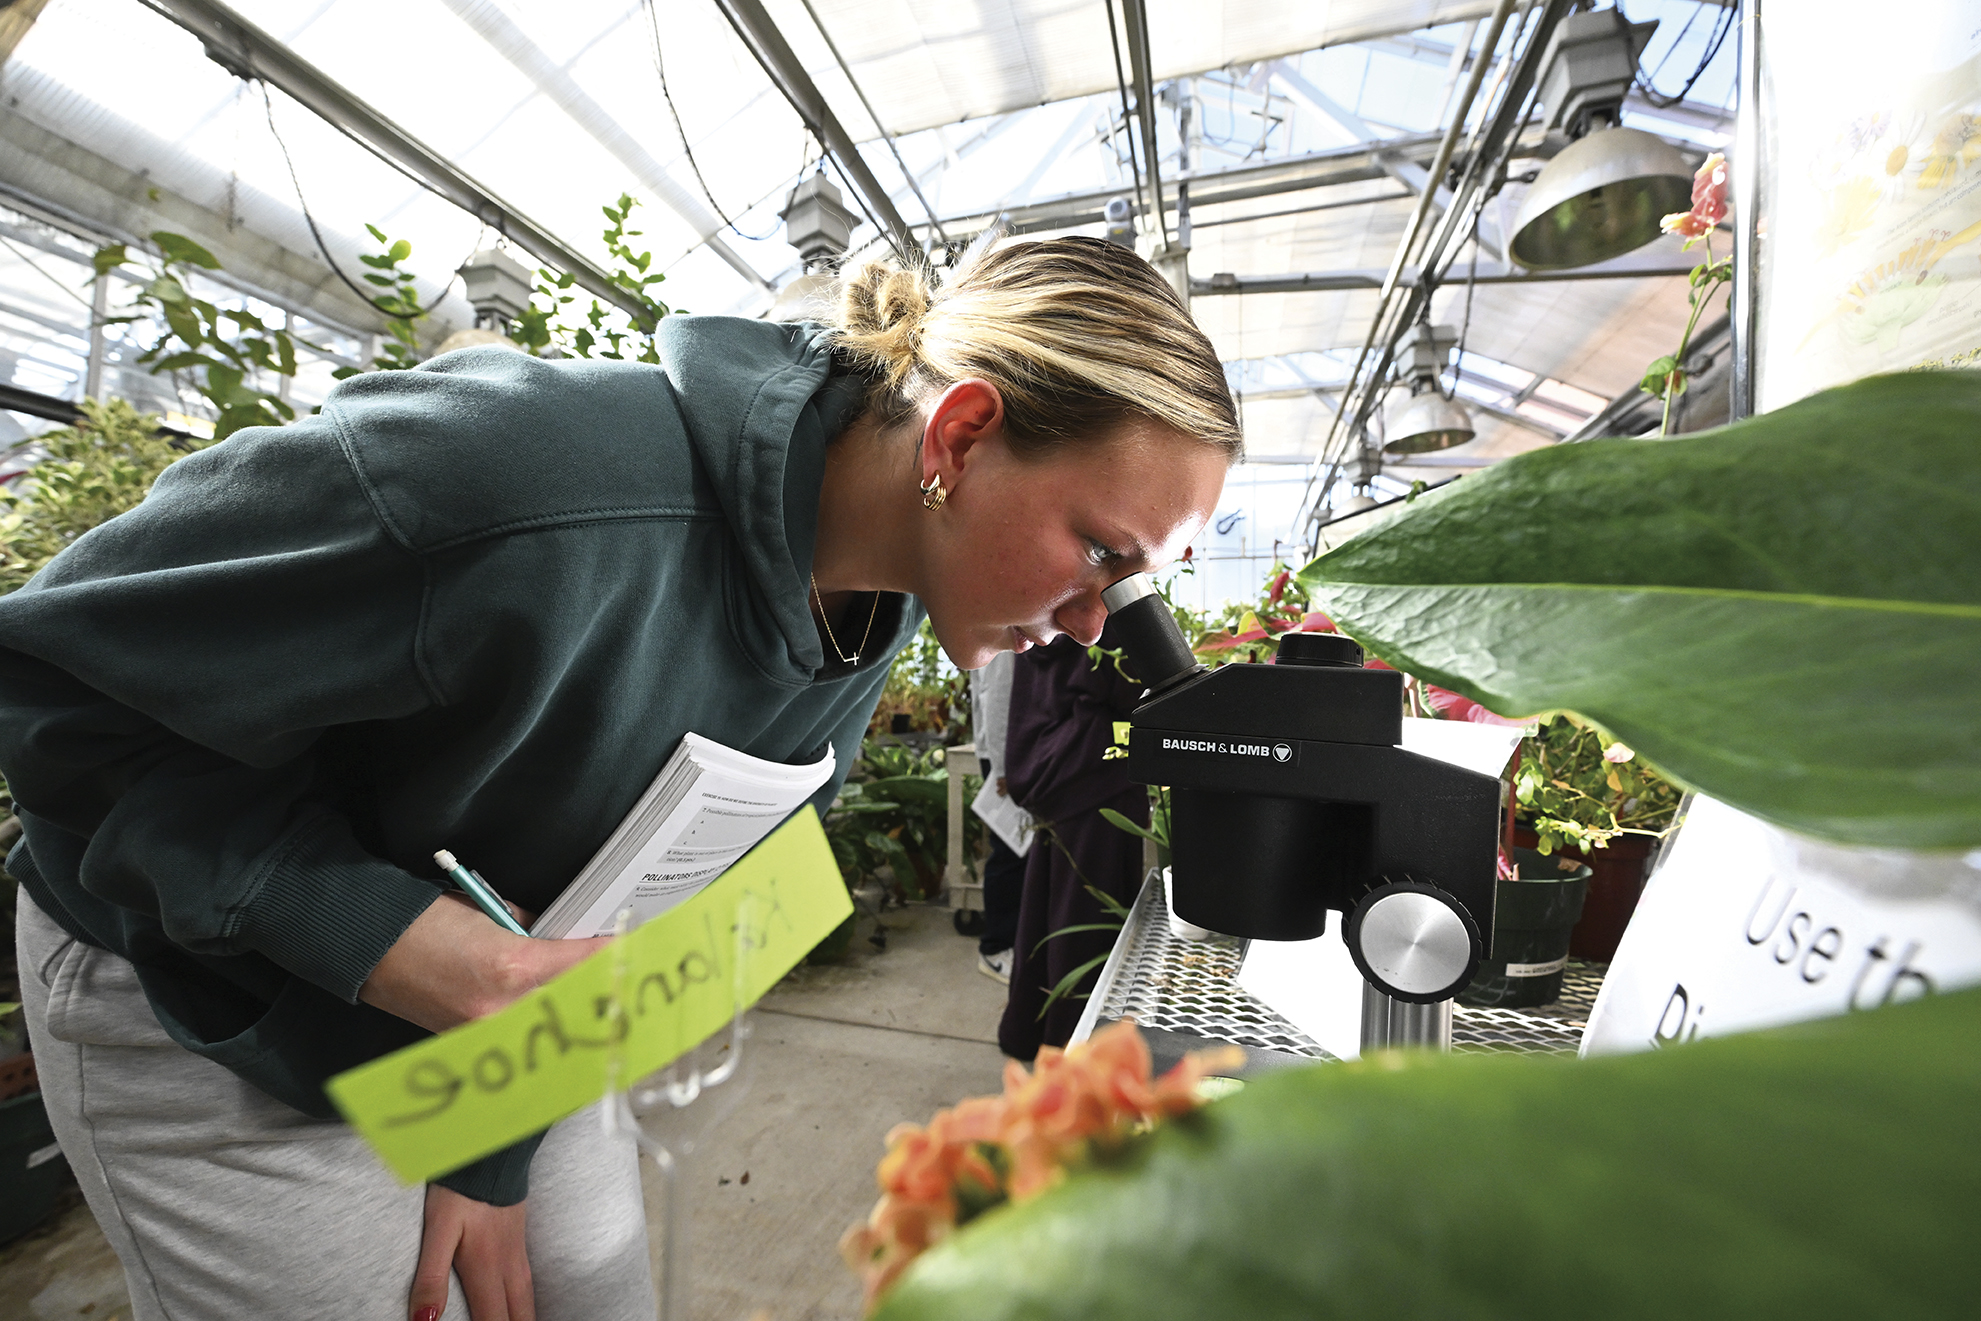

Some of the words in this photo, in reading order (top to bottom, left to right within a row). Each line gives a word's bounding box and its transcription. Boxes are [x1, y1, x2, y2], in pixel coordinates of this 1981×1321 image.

[1162, 738, 1216, 752] BAUSCH
[1218, 742, 1228, 754] &
[1230, 743, 1270, 757] LOMB
[641, 872, 693, 881] POLLINATORS
[1742, 874, 1843, 985] Use
